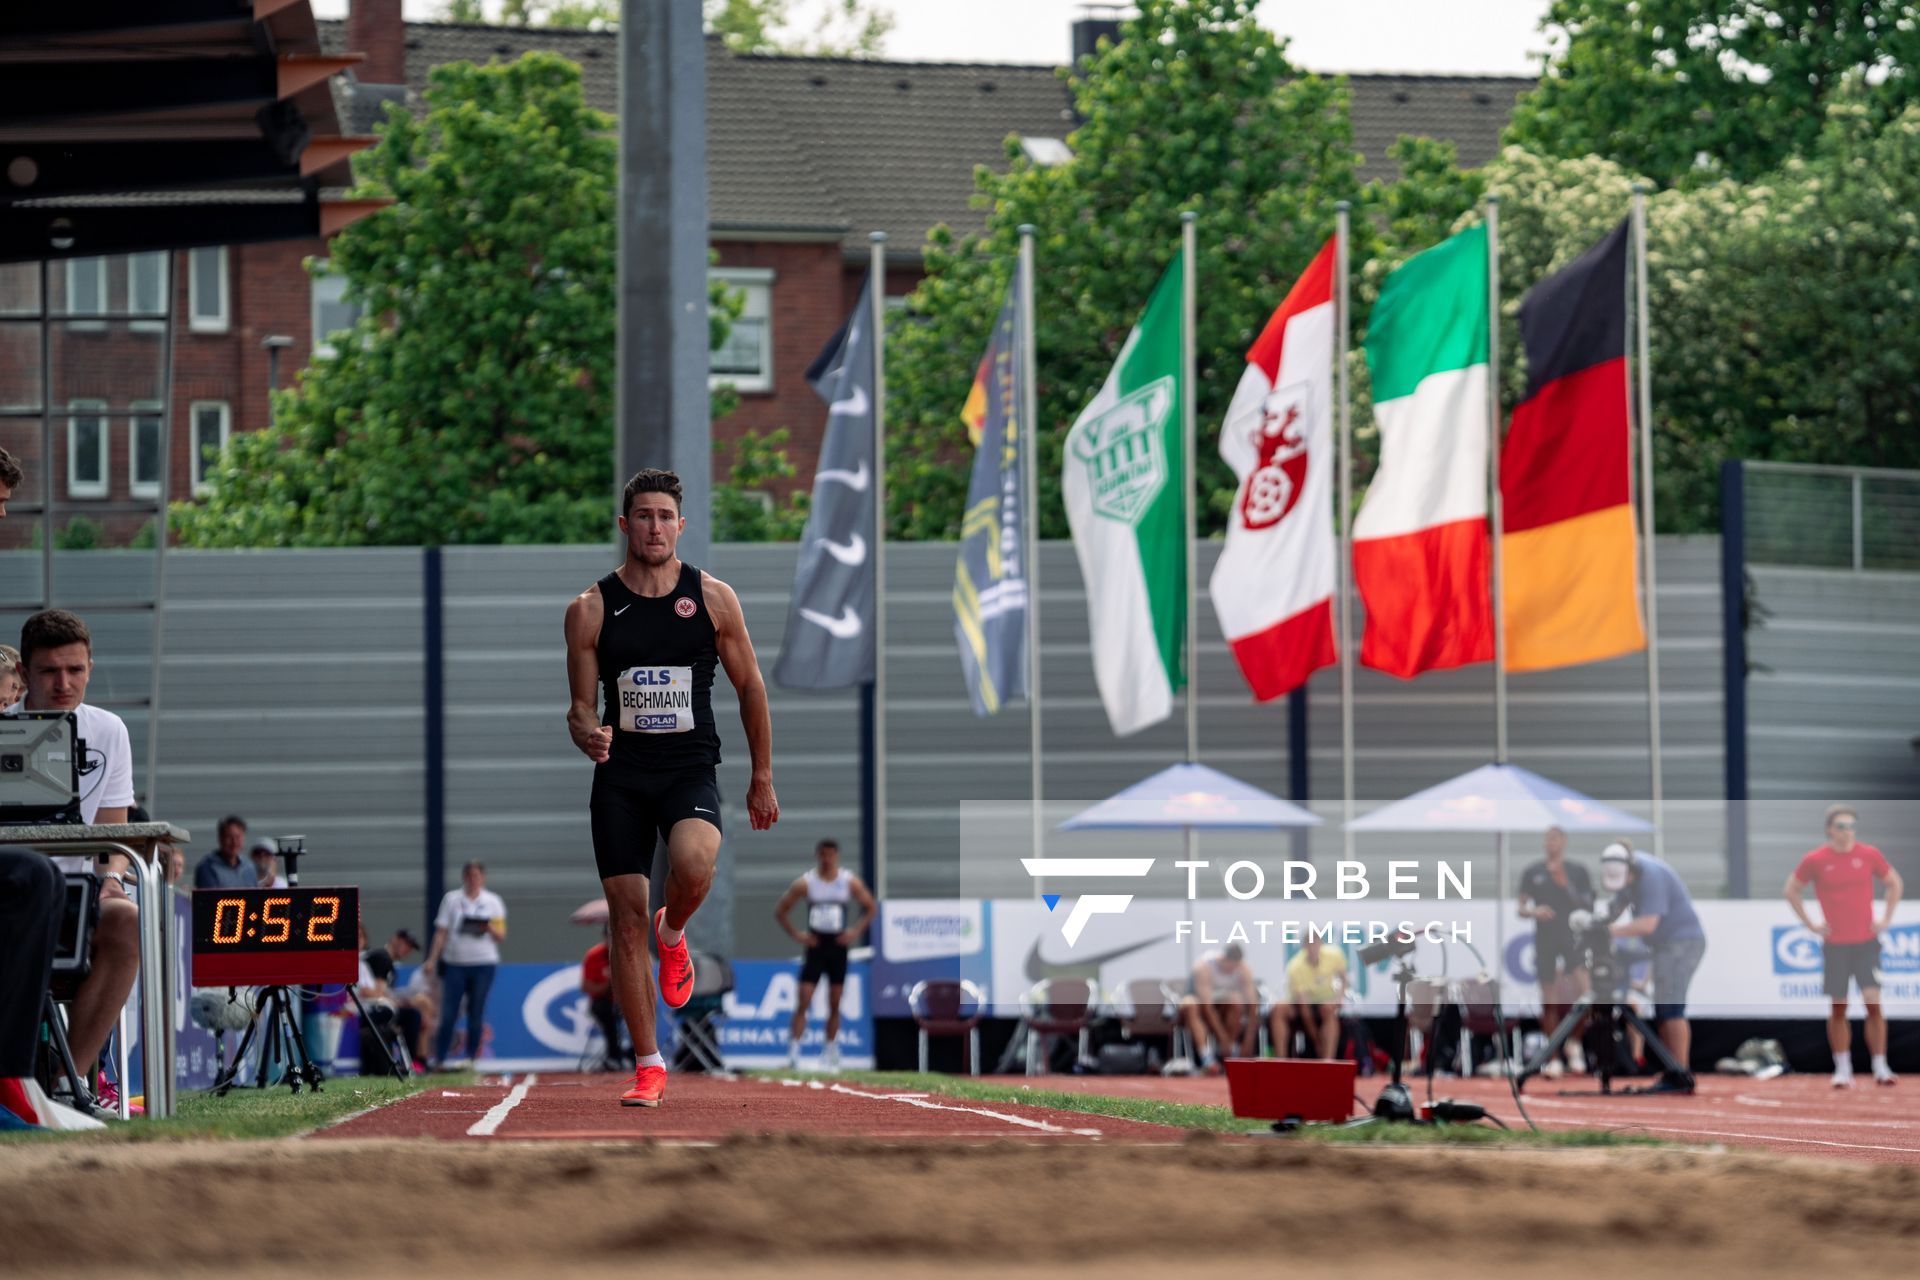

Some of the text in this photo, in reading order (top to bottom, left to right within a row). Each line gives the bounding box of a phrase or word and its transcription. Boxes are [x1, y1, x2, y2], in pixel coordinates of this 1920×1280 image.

[623, 691, 689, 709] BECHMANN
[651, 717, 675, 725] PLAN
[213, 896, 340, 944] 0:52
[722, 973, 863, 1020] LAN
